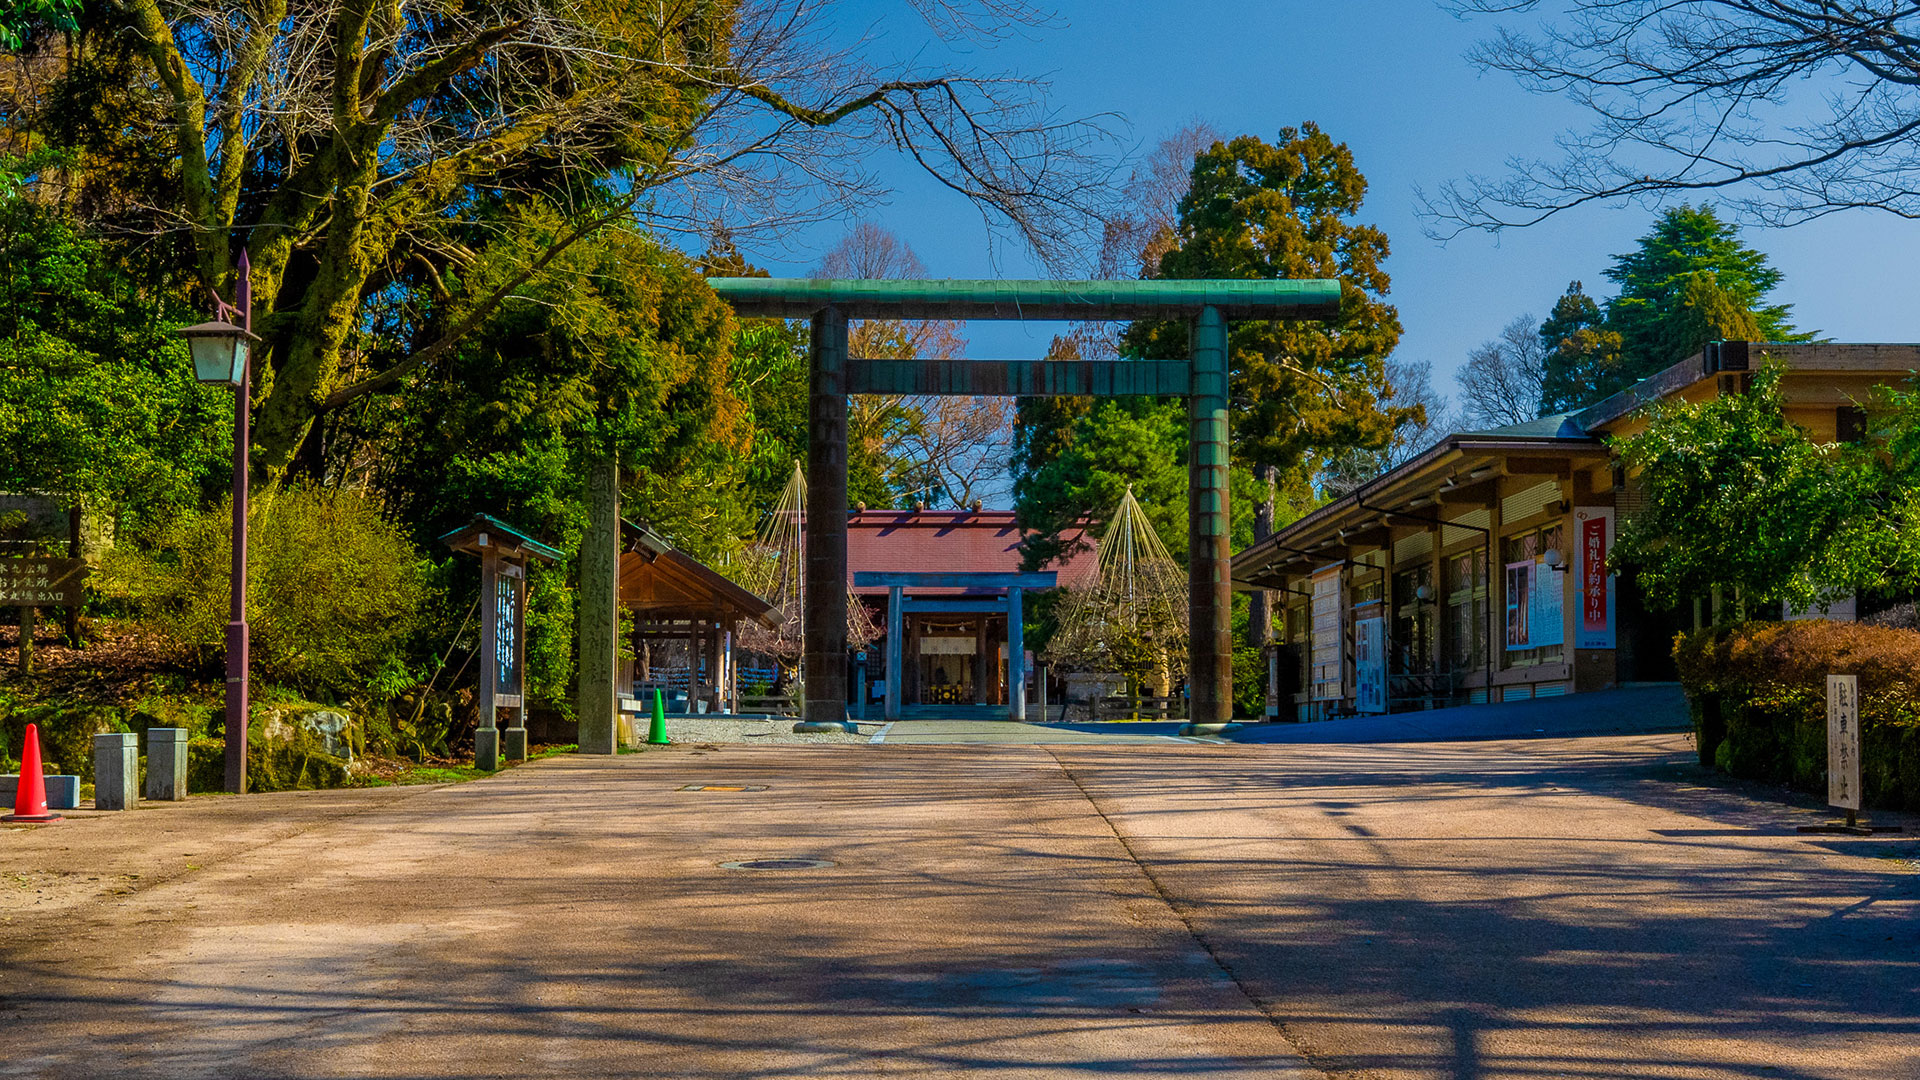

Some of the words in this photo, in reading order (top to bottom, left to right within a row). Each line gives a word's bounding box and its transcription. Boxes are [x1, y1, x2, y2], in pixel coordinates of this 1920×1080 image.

[37, 591, 64, 601] 出入口
[1588, 525, 1601, 621] ご婚礼予約承り中
[1839, 682, 1849, 800] 駐車禁止
